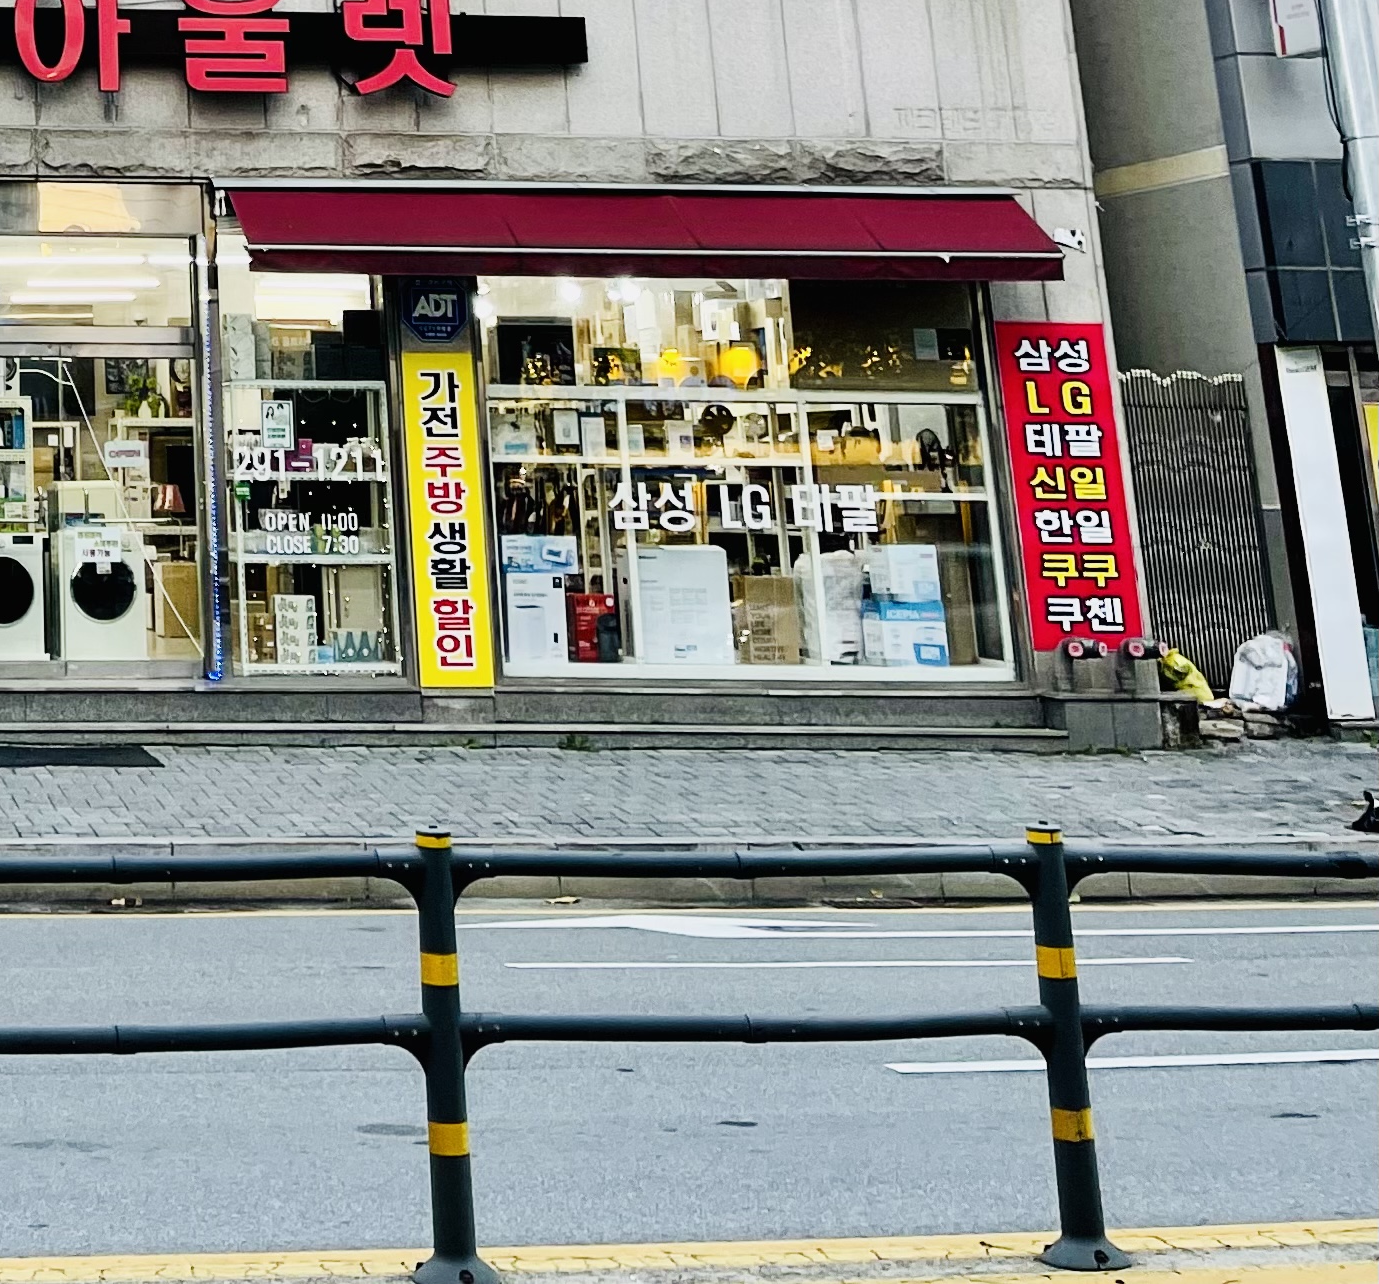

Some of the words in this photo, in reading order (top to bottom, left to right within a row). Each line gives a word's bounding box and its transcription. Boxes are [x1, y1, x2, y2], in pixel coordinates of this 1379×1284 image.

[412, 294, 457, 317] ADT
[1014, 339, 1089, 374] 삼성
[1026, 423, 1102, 457] 테팔
[233, 448, 387, 482] 291-1211
[1029, 466, 1107, 501] 신일
[265, 513, 310, 531] OPEN
[609, 482, 697, 531] 삼성
[720, 484, 772, 530] LG
[792, 483, 879, 533] 테팔
[1034, 509, 1113, 544] 한일
[266, 535, 312, 554] CLOSE
[322, 535, 360, 554] 7:30
[1042, 553, 1119, 588] 쿠쿠
[1047, 597, 1124, 632] 쿠첸
